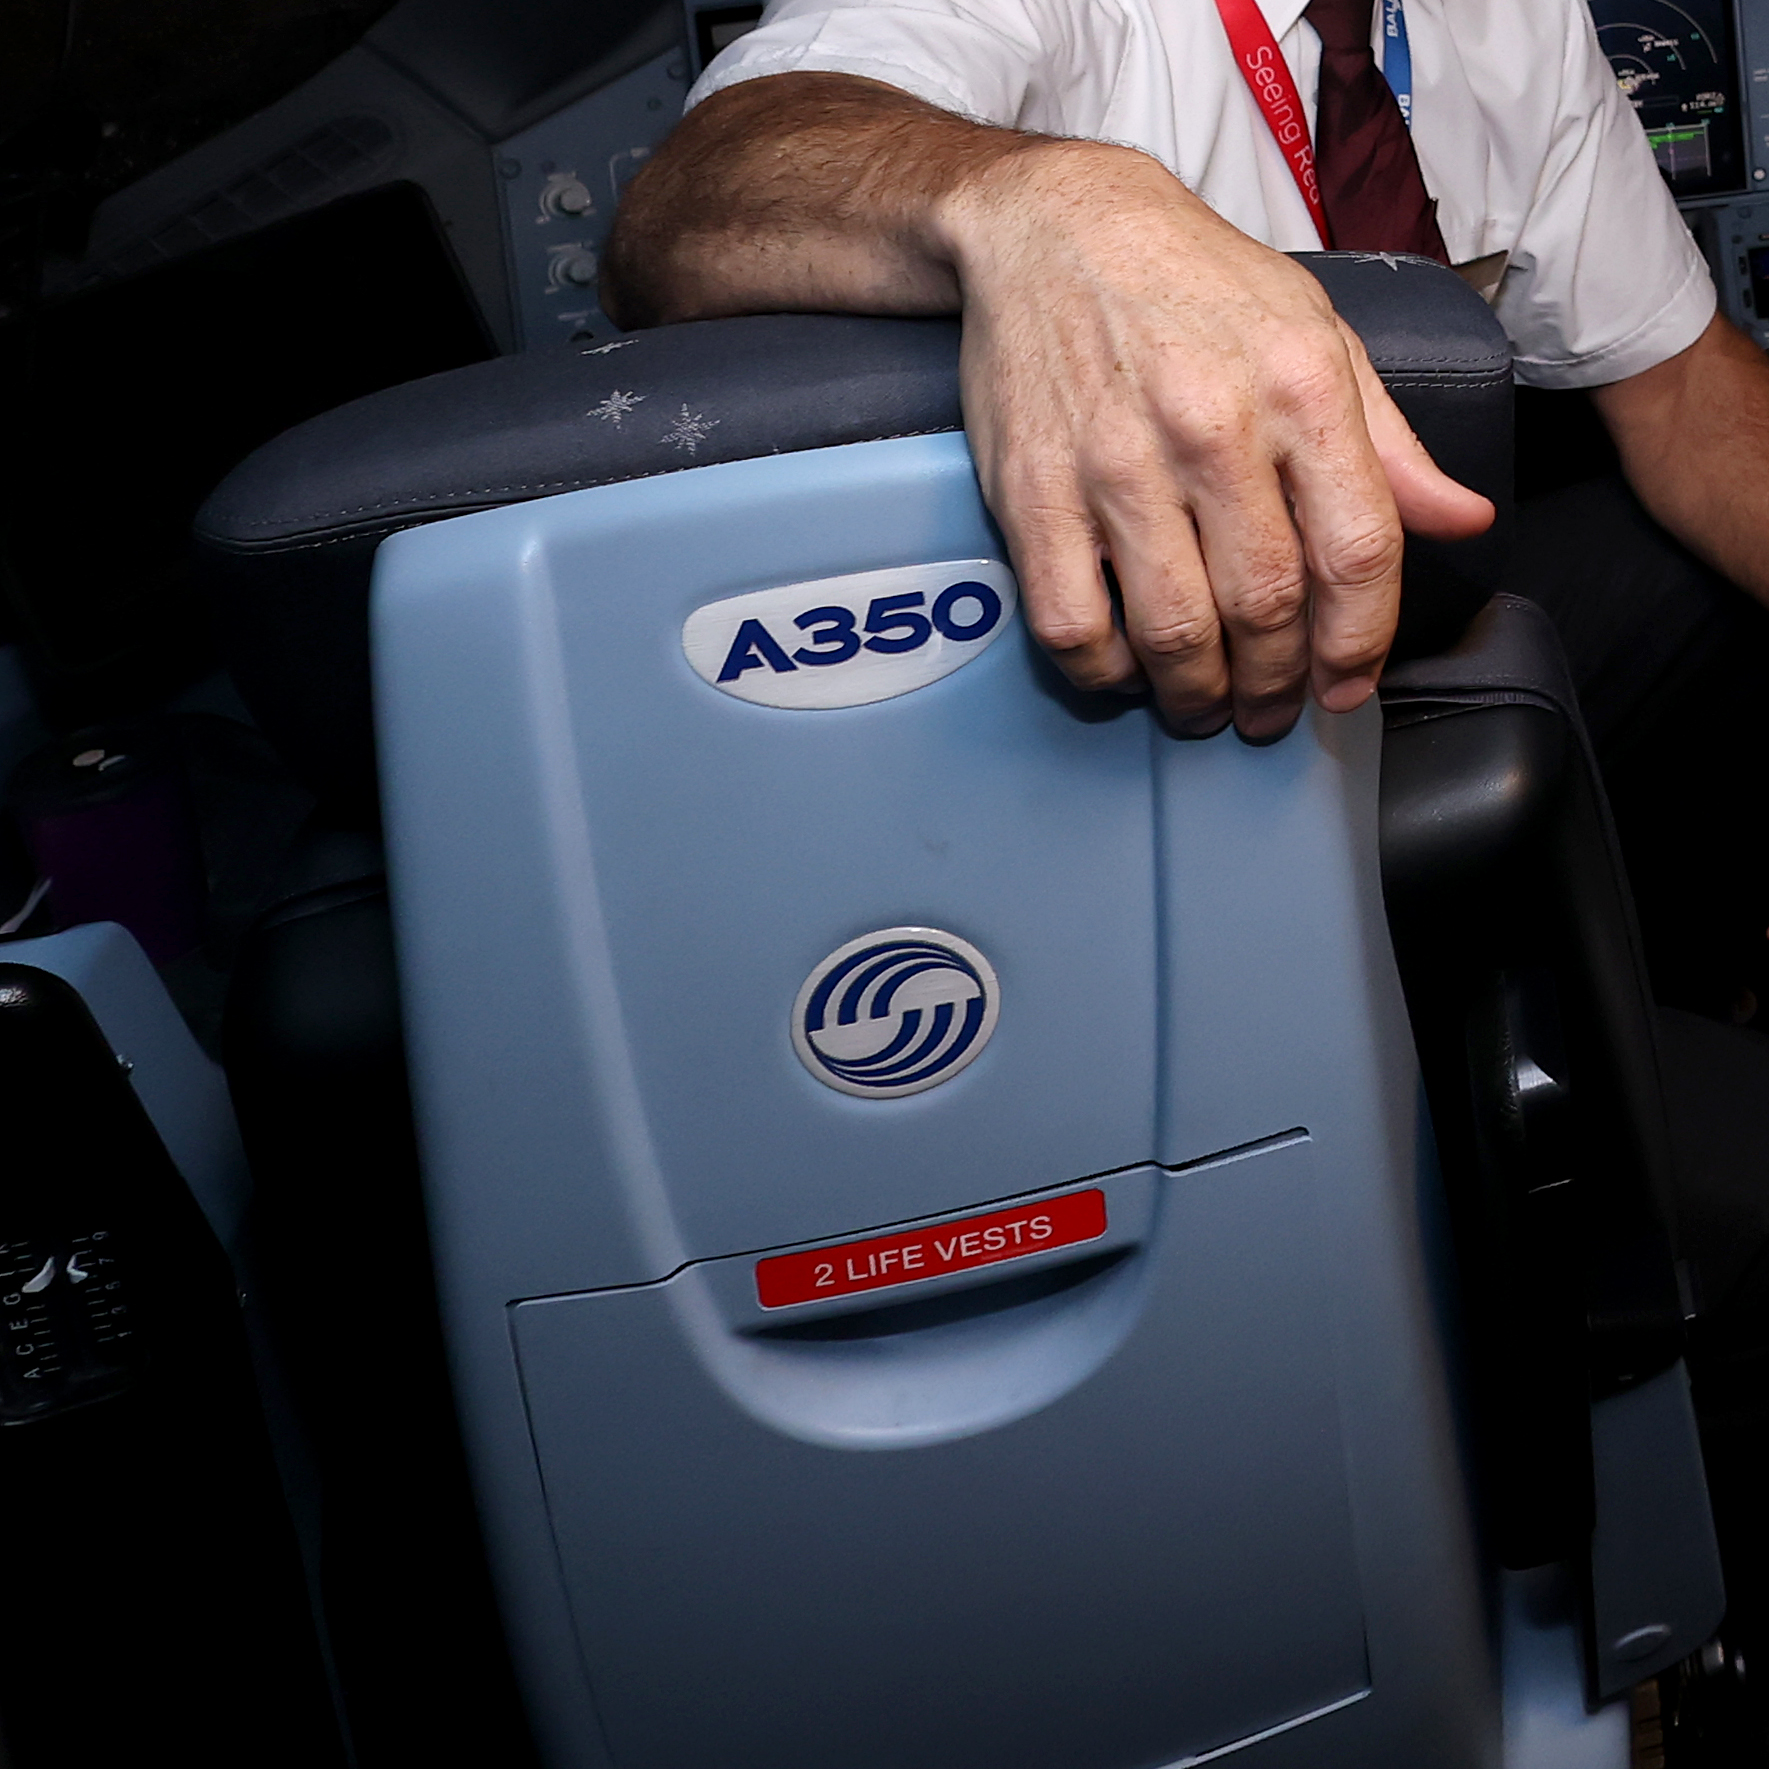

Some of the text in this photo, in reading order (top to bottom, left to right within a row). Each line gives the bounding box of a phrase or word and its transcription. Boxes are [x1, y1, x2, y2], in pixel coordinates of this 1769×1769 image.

[1245, 45, 1302, 146] Seeing
[716, 581, 1002, 683] A350
[813, 1215, 1054, 1287] 2 LIFE VESTS
